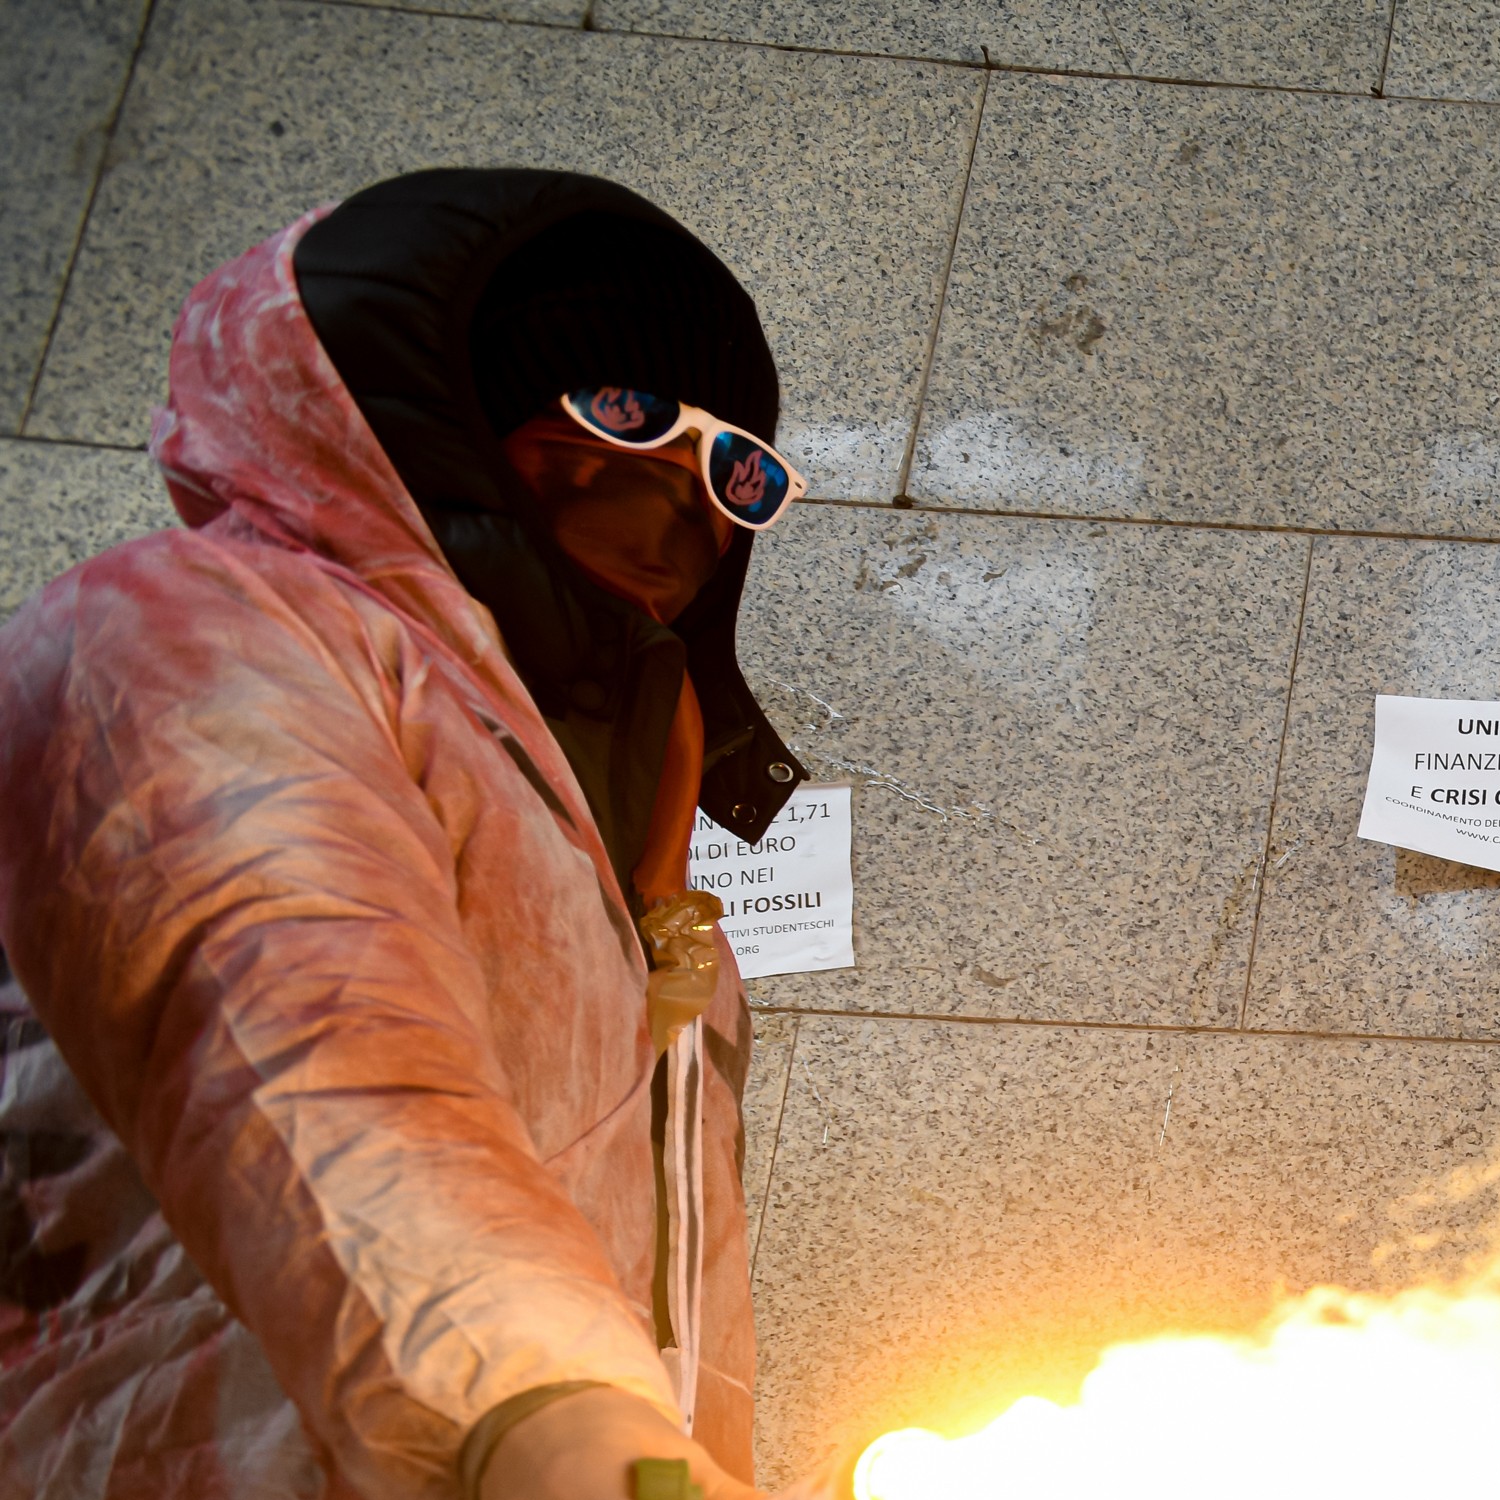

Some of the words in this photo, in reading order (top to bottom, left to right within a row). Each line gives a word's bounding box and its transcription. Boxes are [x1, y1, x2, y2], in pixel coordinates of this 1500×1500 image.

[1411, 785, 1423, 799] E
[1430, 788, 1487, 806] CRISI
[788, 803, 831, 824] 1,71
[1385, 796, 1482, 827] COORDINAMENTO
[1484, 819, 1500, 828] DEI
[708, 844, 729, 860] DI
[737, 836, 796, 857] EURO
[741, 867, 774, 886] NEI
[743, 892, 821, 915] FOSSILI
[753, 919, 834, 936] STUDENTESCHI
